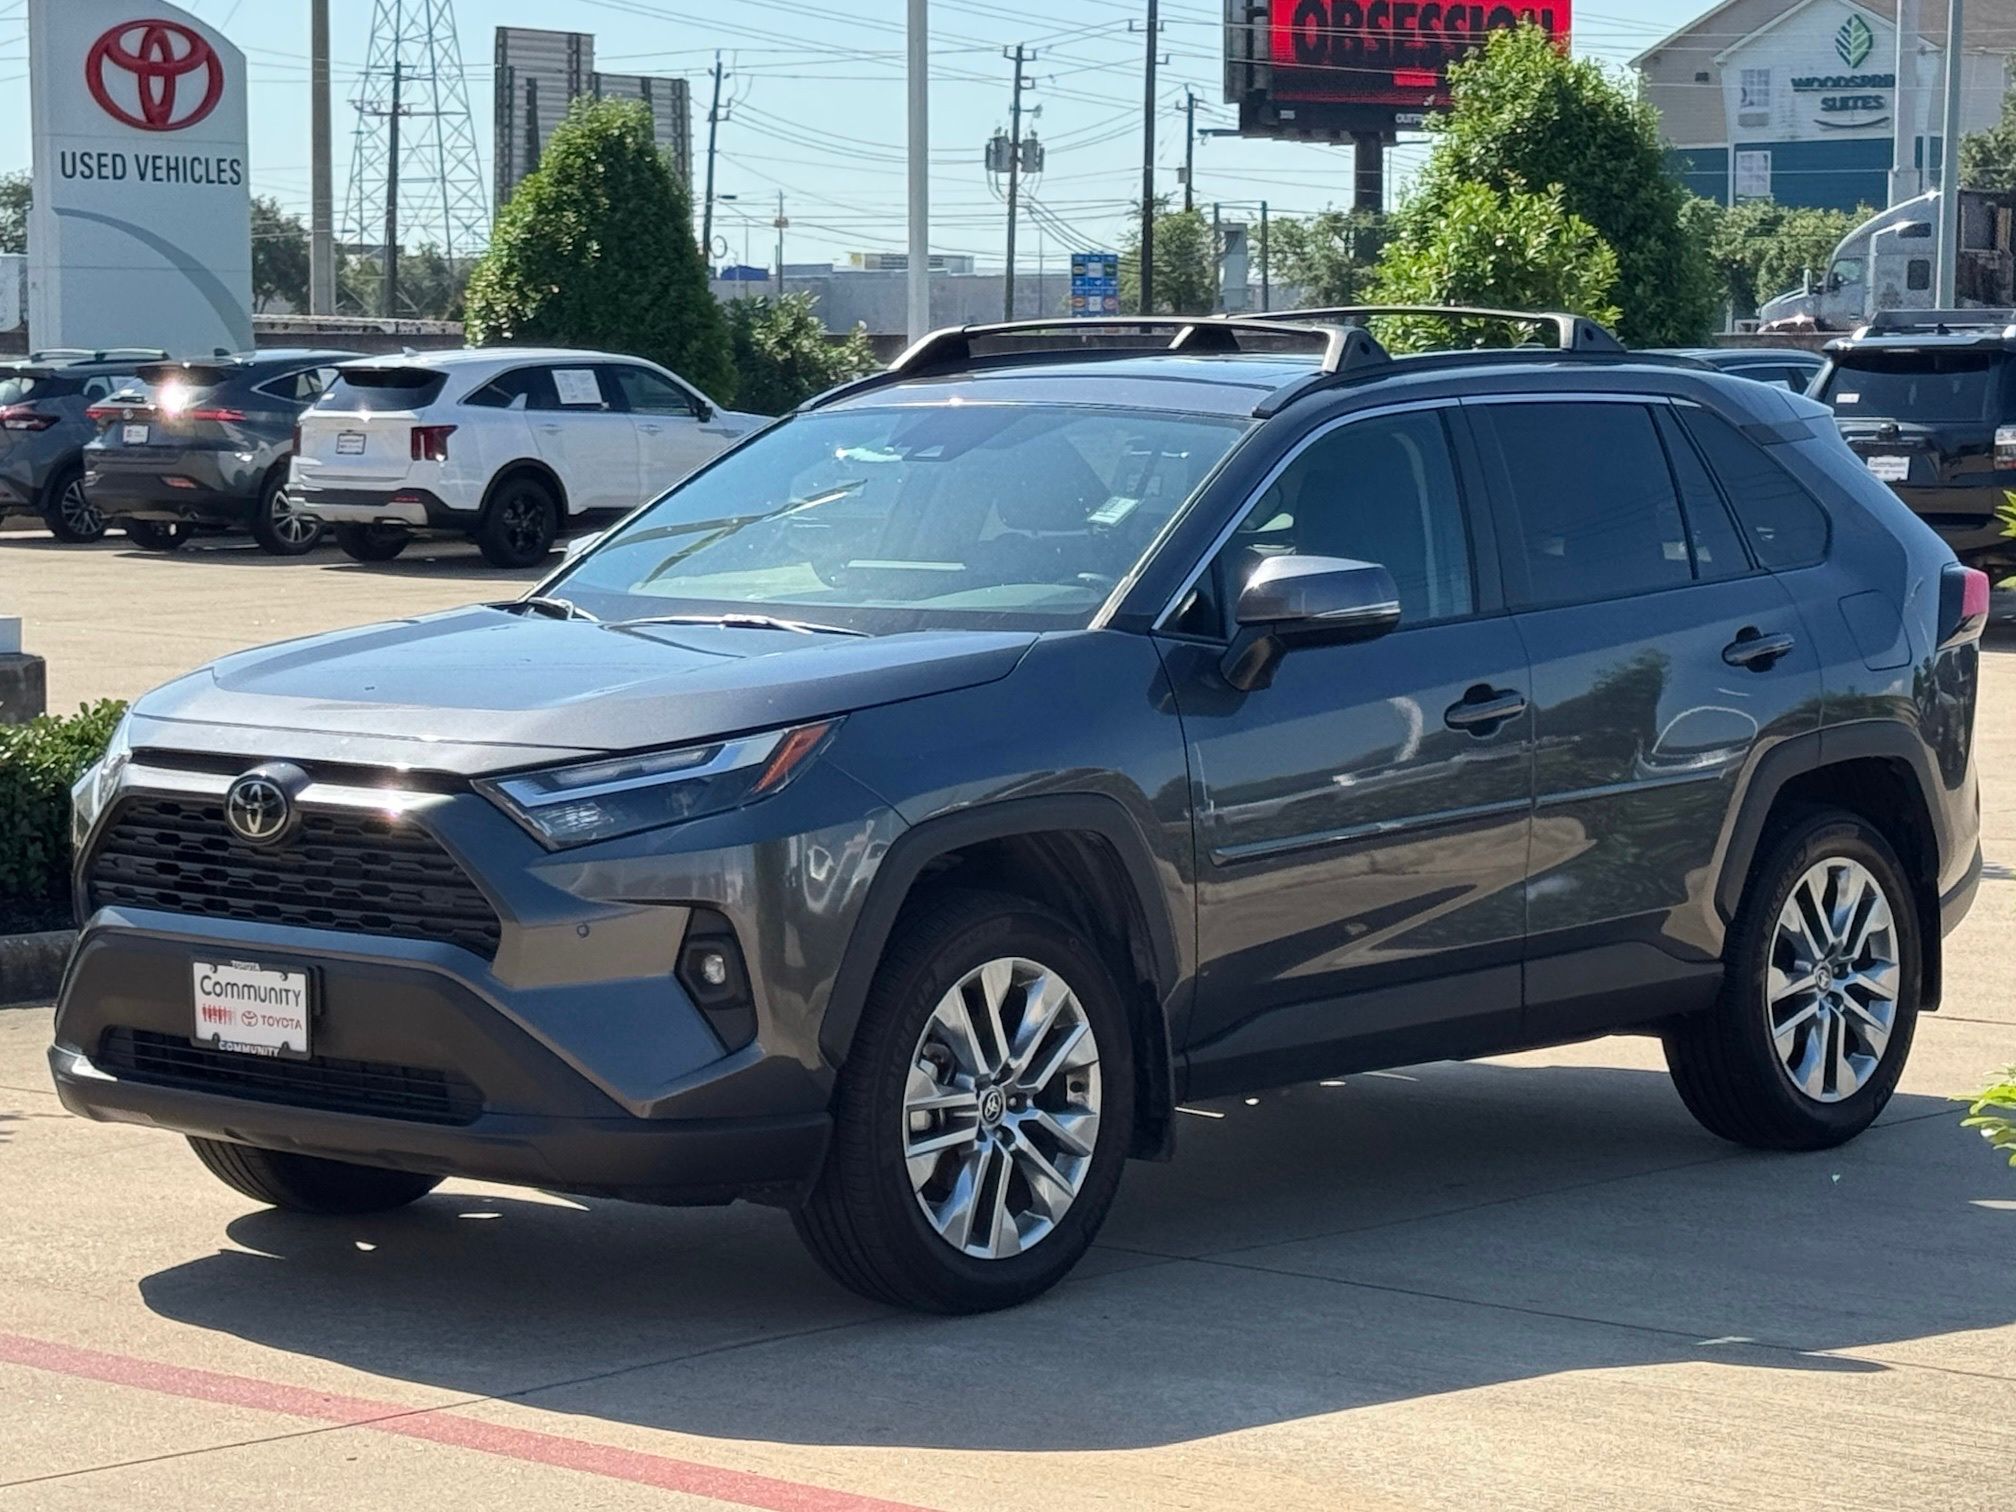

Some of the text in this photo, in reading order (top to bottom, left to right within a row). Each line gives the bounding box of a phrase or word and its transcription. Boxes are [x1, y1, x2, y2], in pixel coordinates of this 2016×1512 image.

[1821, 95, 1885, 112] SUITES
[61, 151, 242, 186] USED VEHICLES
[261, 1014, 303, 1031] TOYOTA
[218, 1041, 280, 1058] COMMUNITY
